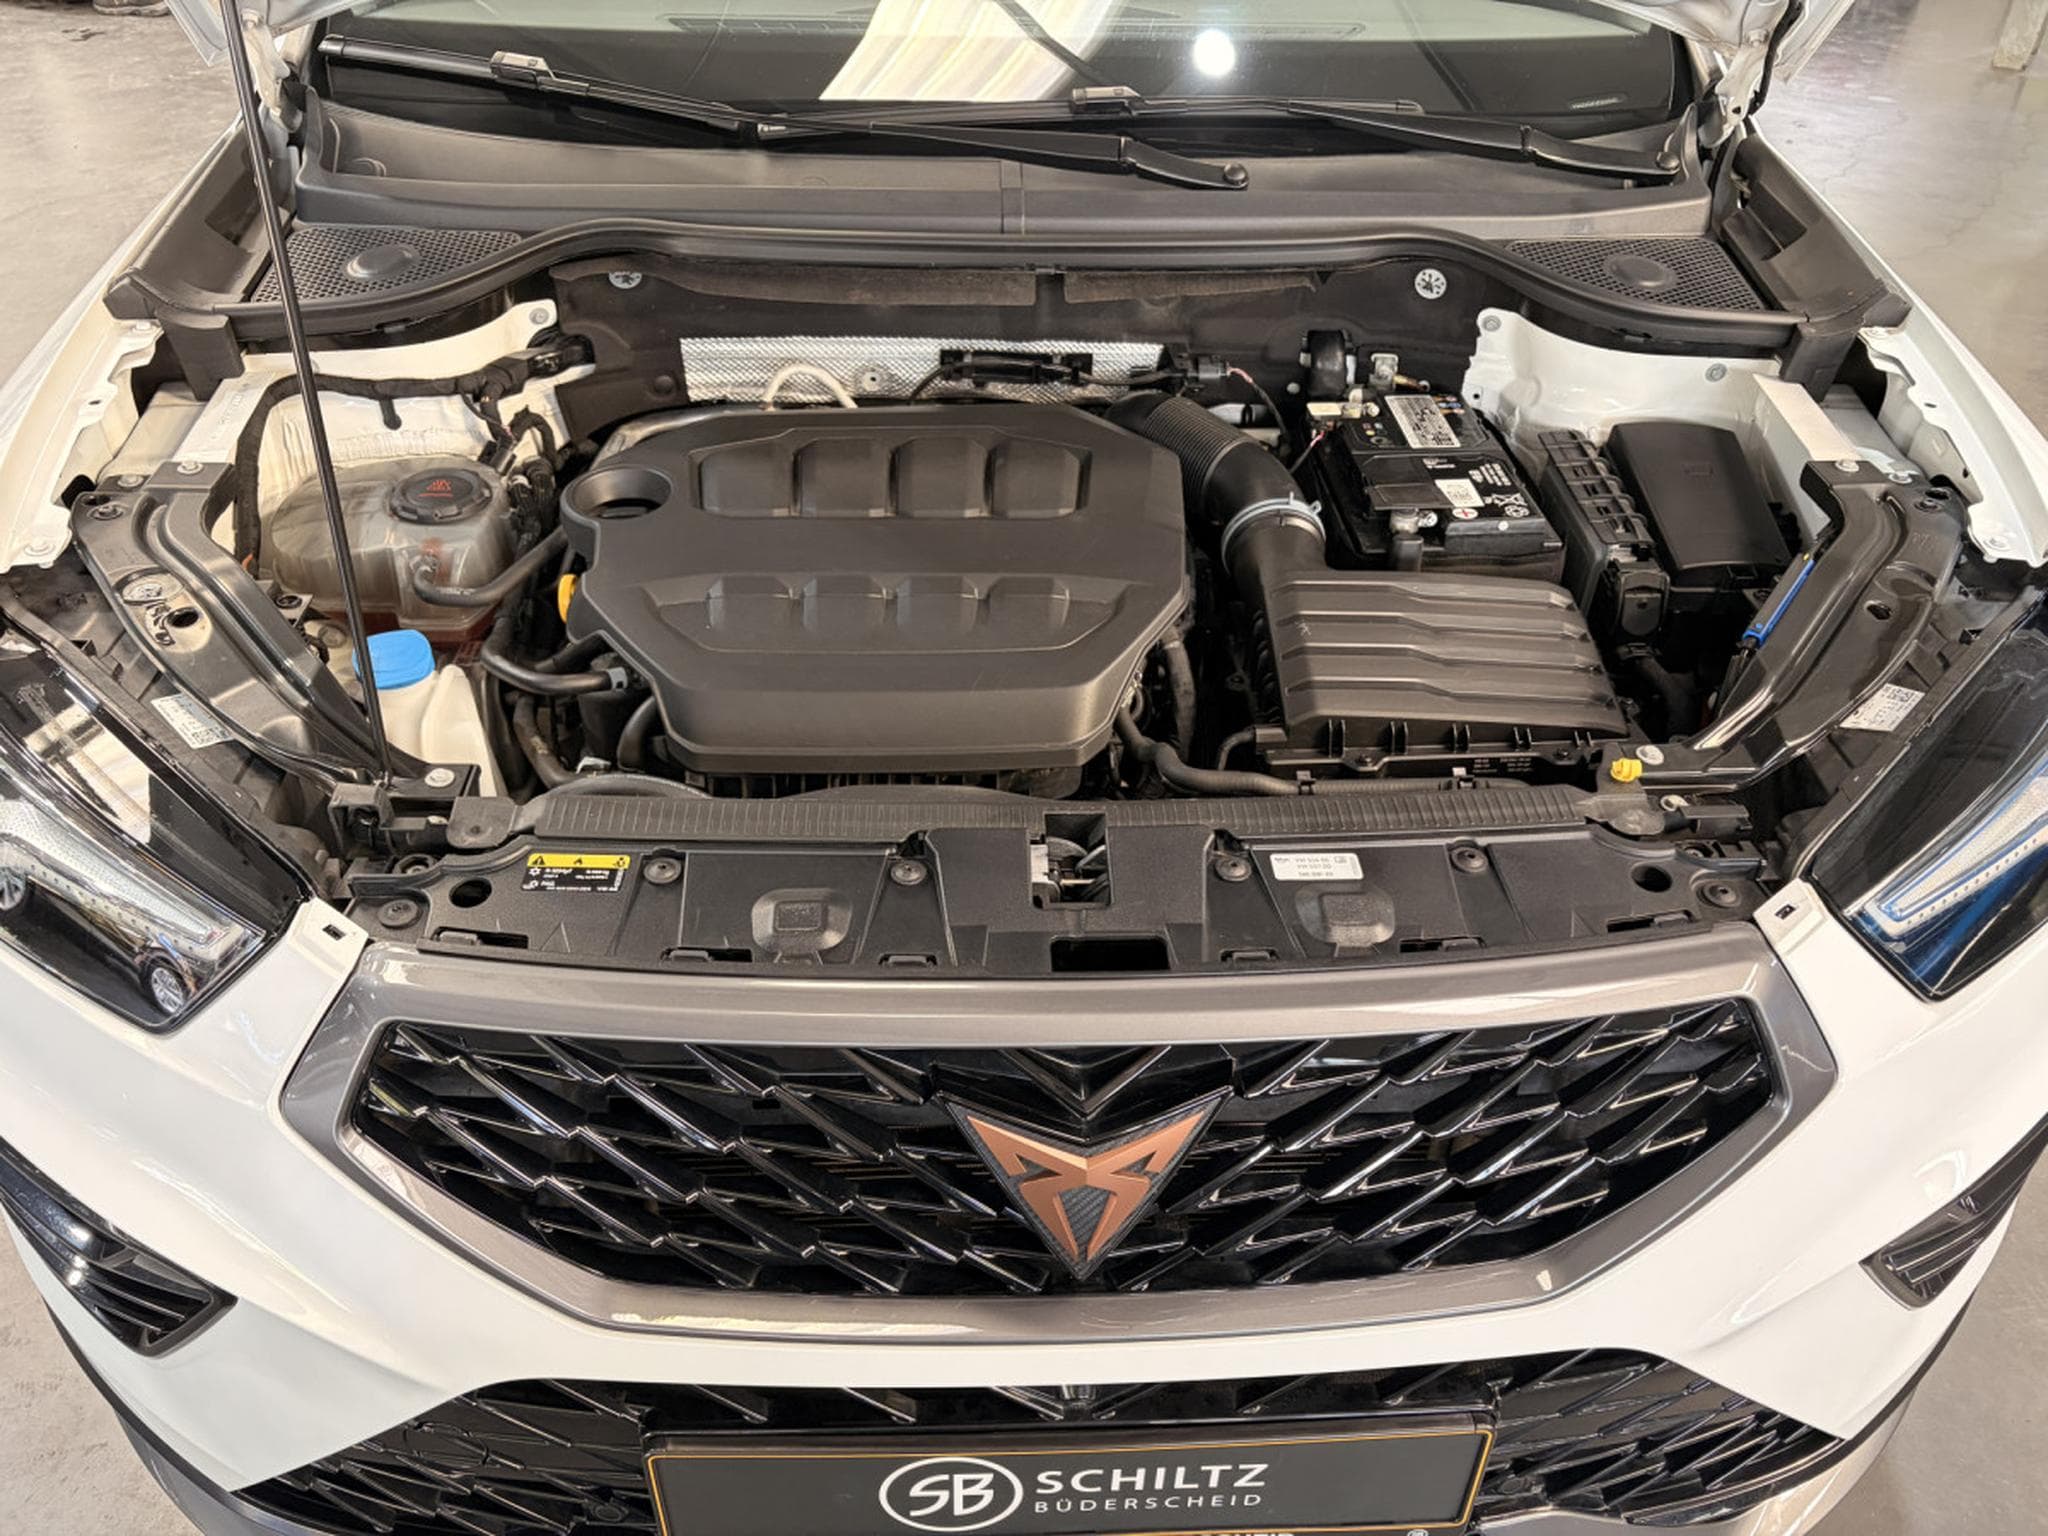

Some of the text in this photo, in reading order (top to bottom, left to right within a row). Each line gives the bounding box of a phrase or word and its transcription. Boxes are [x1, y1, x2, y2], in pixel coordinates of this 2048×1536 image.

[1035, 1463, 1269, 1494] SCHILTZ
[909, 1473, 994, 1517] SB
[1034, 1494, 1261, 1513] BÜDERSCHEID
